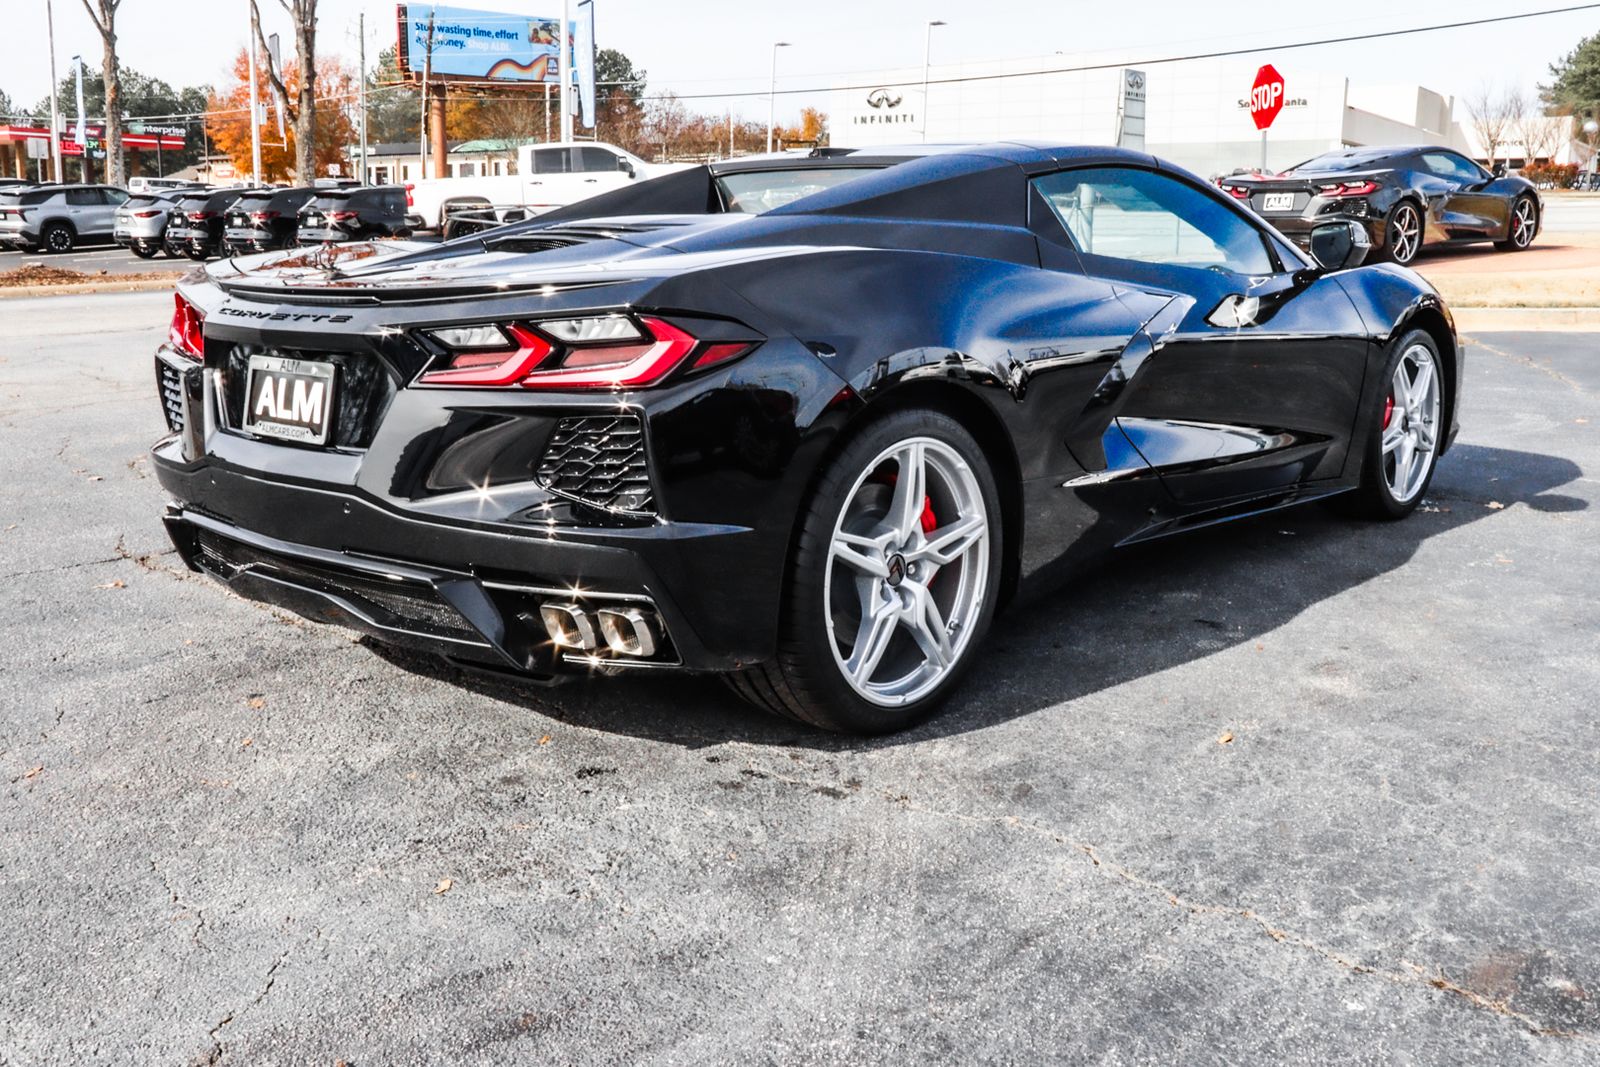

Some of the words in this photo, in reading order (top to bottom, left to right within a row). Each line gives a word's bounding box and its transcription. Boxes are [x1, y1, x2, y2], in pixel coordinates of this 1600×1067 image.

[436, 25, 471, 38] wasting
[472, 27, 495, 39] time,
[494, 30, 519, 40] effort
[1251, 82, 1283, 113] STOP
[854, 114, 914, 125] INFINITI
[1266, 197, 1291, 208] ALM
[218, 307, 353, 323] CORVETTE
[280, 359, 301, 372] ALM
[255, 375, 324, 424] ALM
[261, 423, 306, 437] ALMCARS.COM
